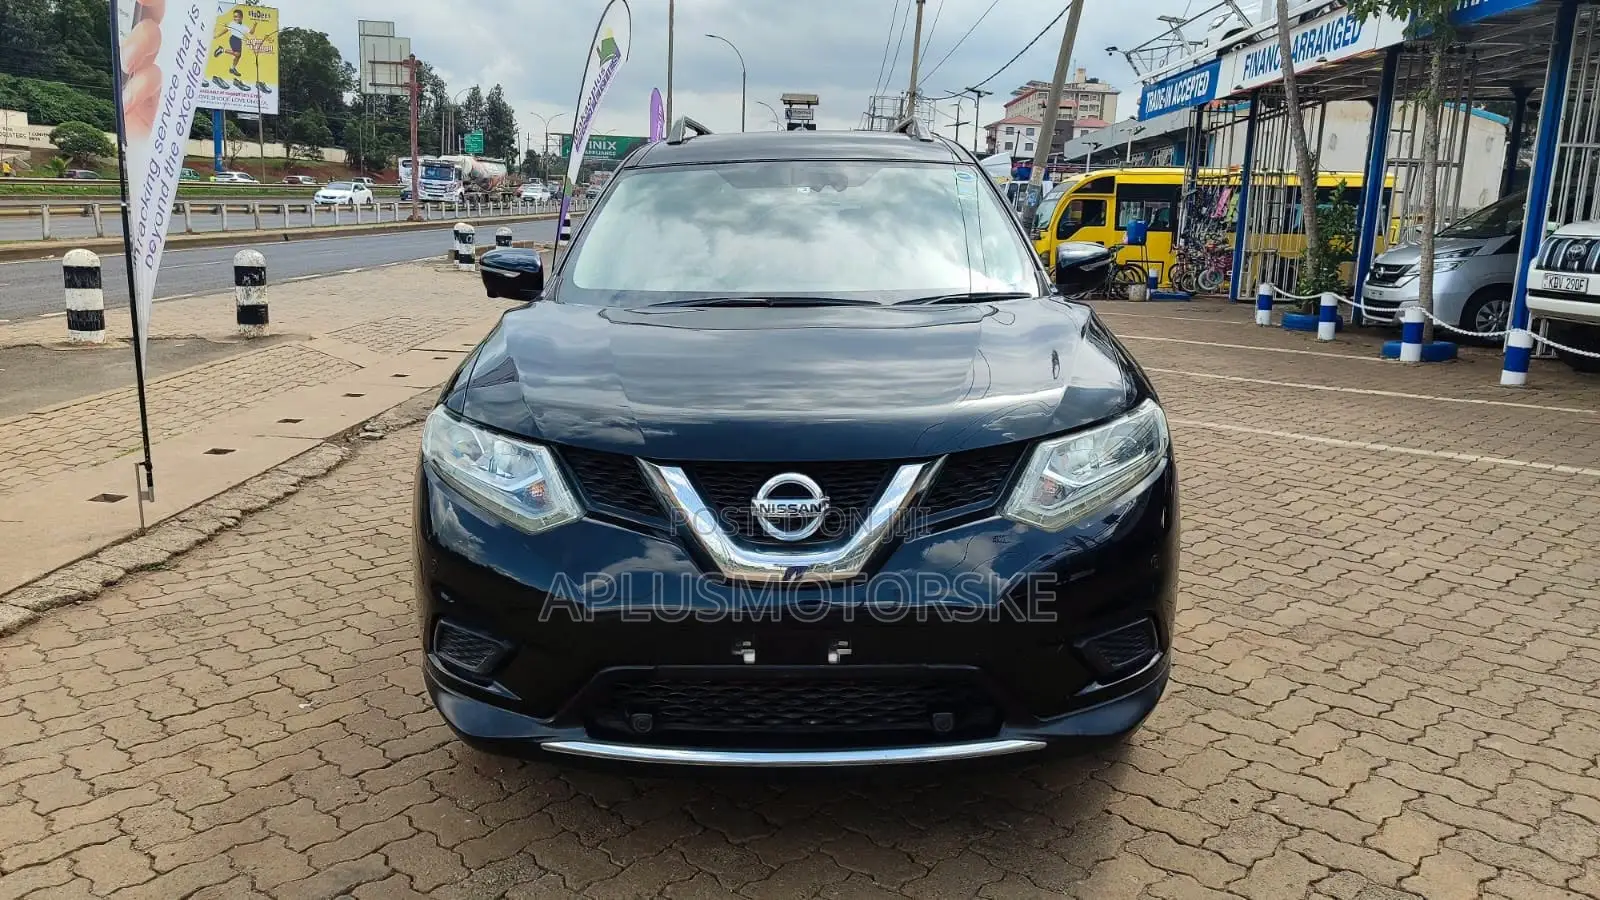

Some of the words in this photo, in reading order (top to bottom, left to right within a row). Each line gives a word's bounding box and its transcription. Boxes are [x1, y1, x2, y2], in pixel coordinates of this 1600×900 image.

[1243, 44, 1282, 80] FINANC
[1291, 14, 1362, 64] ARRANGED
[155, 74, 180, 154] service
[176, 25, 193, 70] that
[187, 4, 200, 25] is
[1145, 83, 1173, 113] TRADE-IN
[1171, 70, 1210, 106] ACCEPTED
[164, 142, 180, 178] the
[175, 39, 207, 137] excellent
[1548, 275, 1563, 288] KDV
[760, 503, 821, 513] NISSAN
